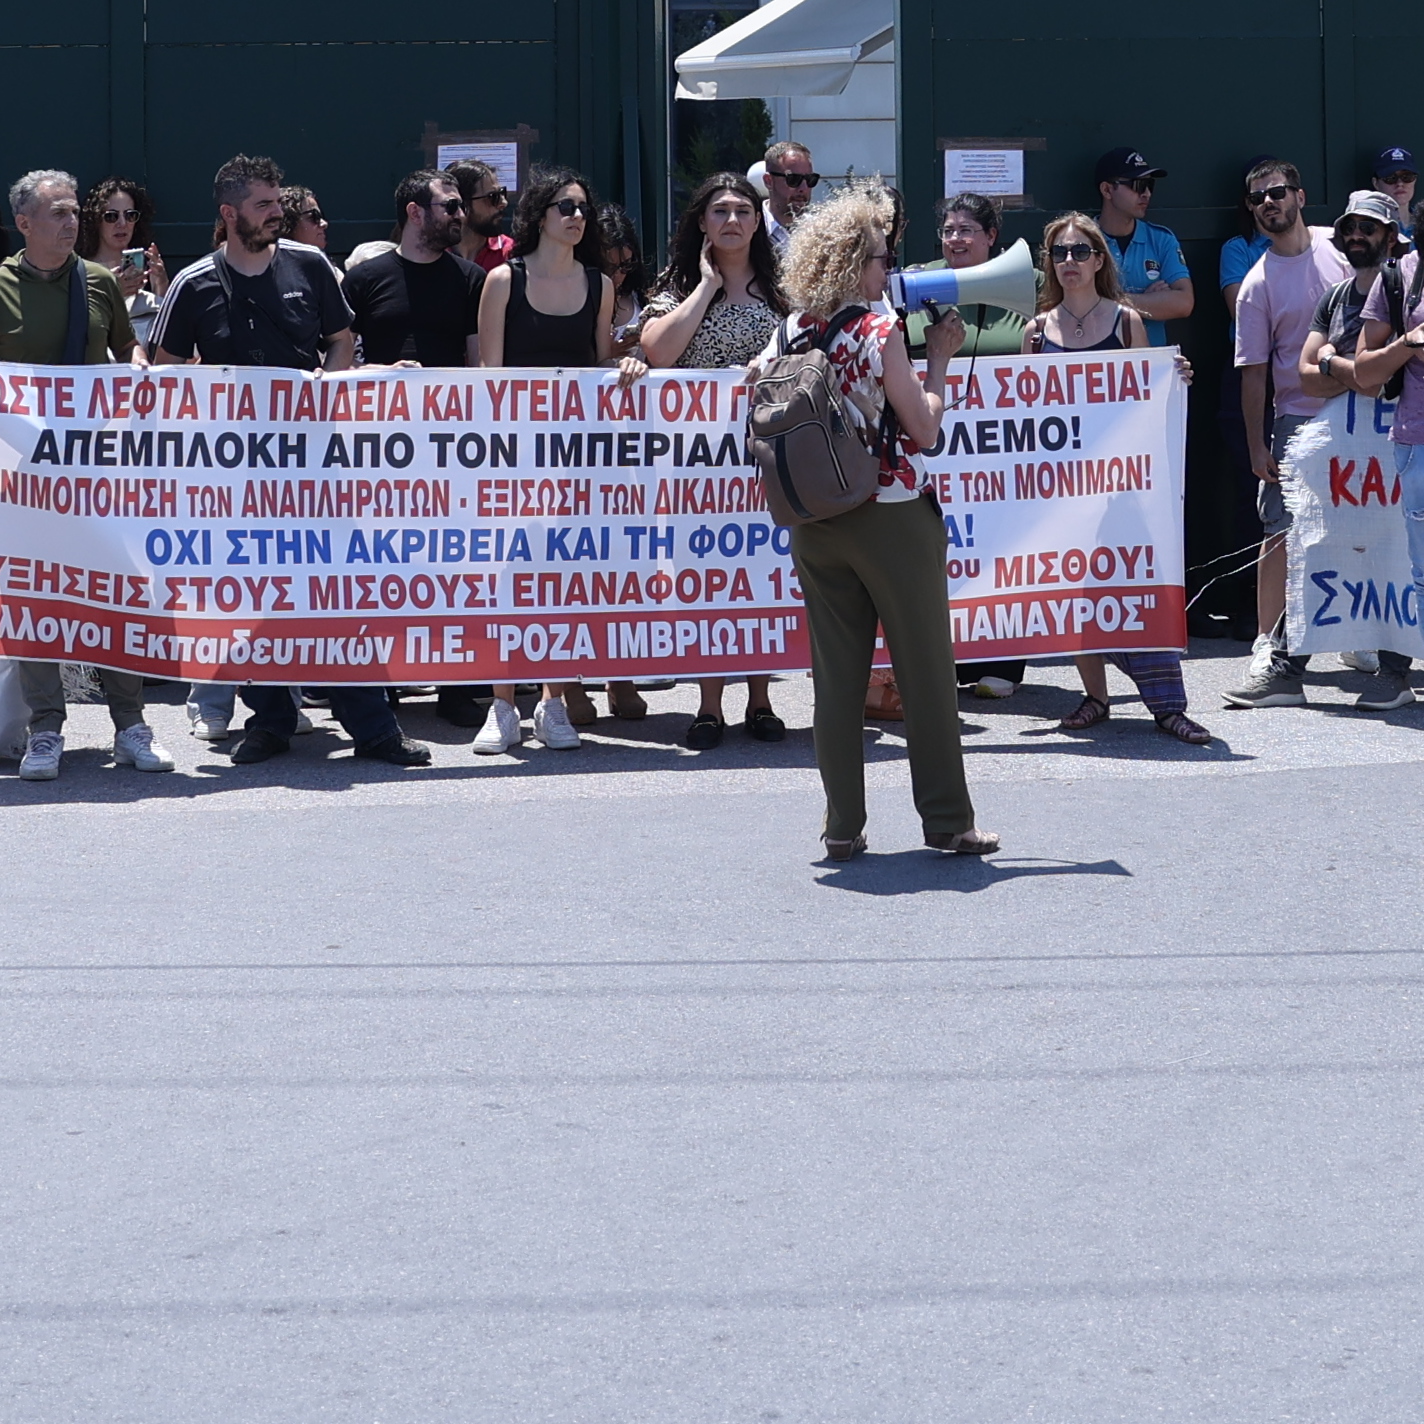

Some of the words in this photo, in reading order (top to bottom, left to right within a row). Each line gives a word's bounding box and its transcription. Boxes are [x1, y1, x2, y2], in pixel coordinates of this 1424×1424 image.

[87, 377, 197, 420] ΛΕΦΤΑ
[208, 383, 256, 421] ΓΙΑ
[270, 379, 409, 421] ΠΑΙΔΕΙΑ
[422, 383, 474, 421] ΚΑΙ
[485, 380, 586, 421] ΥΓΕΙΑ
[597, 381, 647, 421] ΚΑΙ
[659, 379, 717, 421] ΟΧΙ
[995, 359, 1151, 410] ΣΦΑΓΕΙΑ!
[30, 428, 308, 469] ΑΠΕΜΠΛΟΚΗ
[322, 432, 414, 468] ΑΠΟ
[429, 433, 518, 469] ΤΟΝ
[241, 479, 450, 518] ΑΝΑΠΛΗΡΩΤΩΝ
[477, 477, 591, 518] ΕΞΙΣΩΣΗ
[959, 472, 1007, 503] ΤΩΝ
[1015, 454, 1153, 501] ΜΟΝΙΜΩΝ!
[146, 528, 212, 566] ΟΧΙ
[226, 528, 332, 565] ΣΤΗΝ
[346, 528, 532, 564] ΑΚΡΙΒΕΙΑ
[546, 526, 610, 562] ΚΑΙ
[623, 525, 675, 560] ΤΗ
[163, 574, 296, 613] ΣΤΟΥΣ
[309, 573, 498, 613] ΜΙΣΘΟΥΣ!
[512, 567, 754, 609] ΕΠΑΝΑΦΟΡΑ
[993, 545, 1155, 588] ΜΙΣΘΟΥ!
[123, 621, 396, 667] Εκπαιδευτικών
[405, 624, 474, 664] Π.Ε.
[485, 621, 597, 663] "ΡΟΖΑ
[607, 615, 798, 658] ΙΜΒΡΙΩΤΗ"
